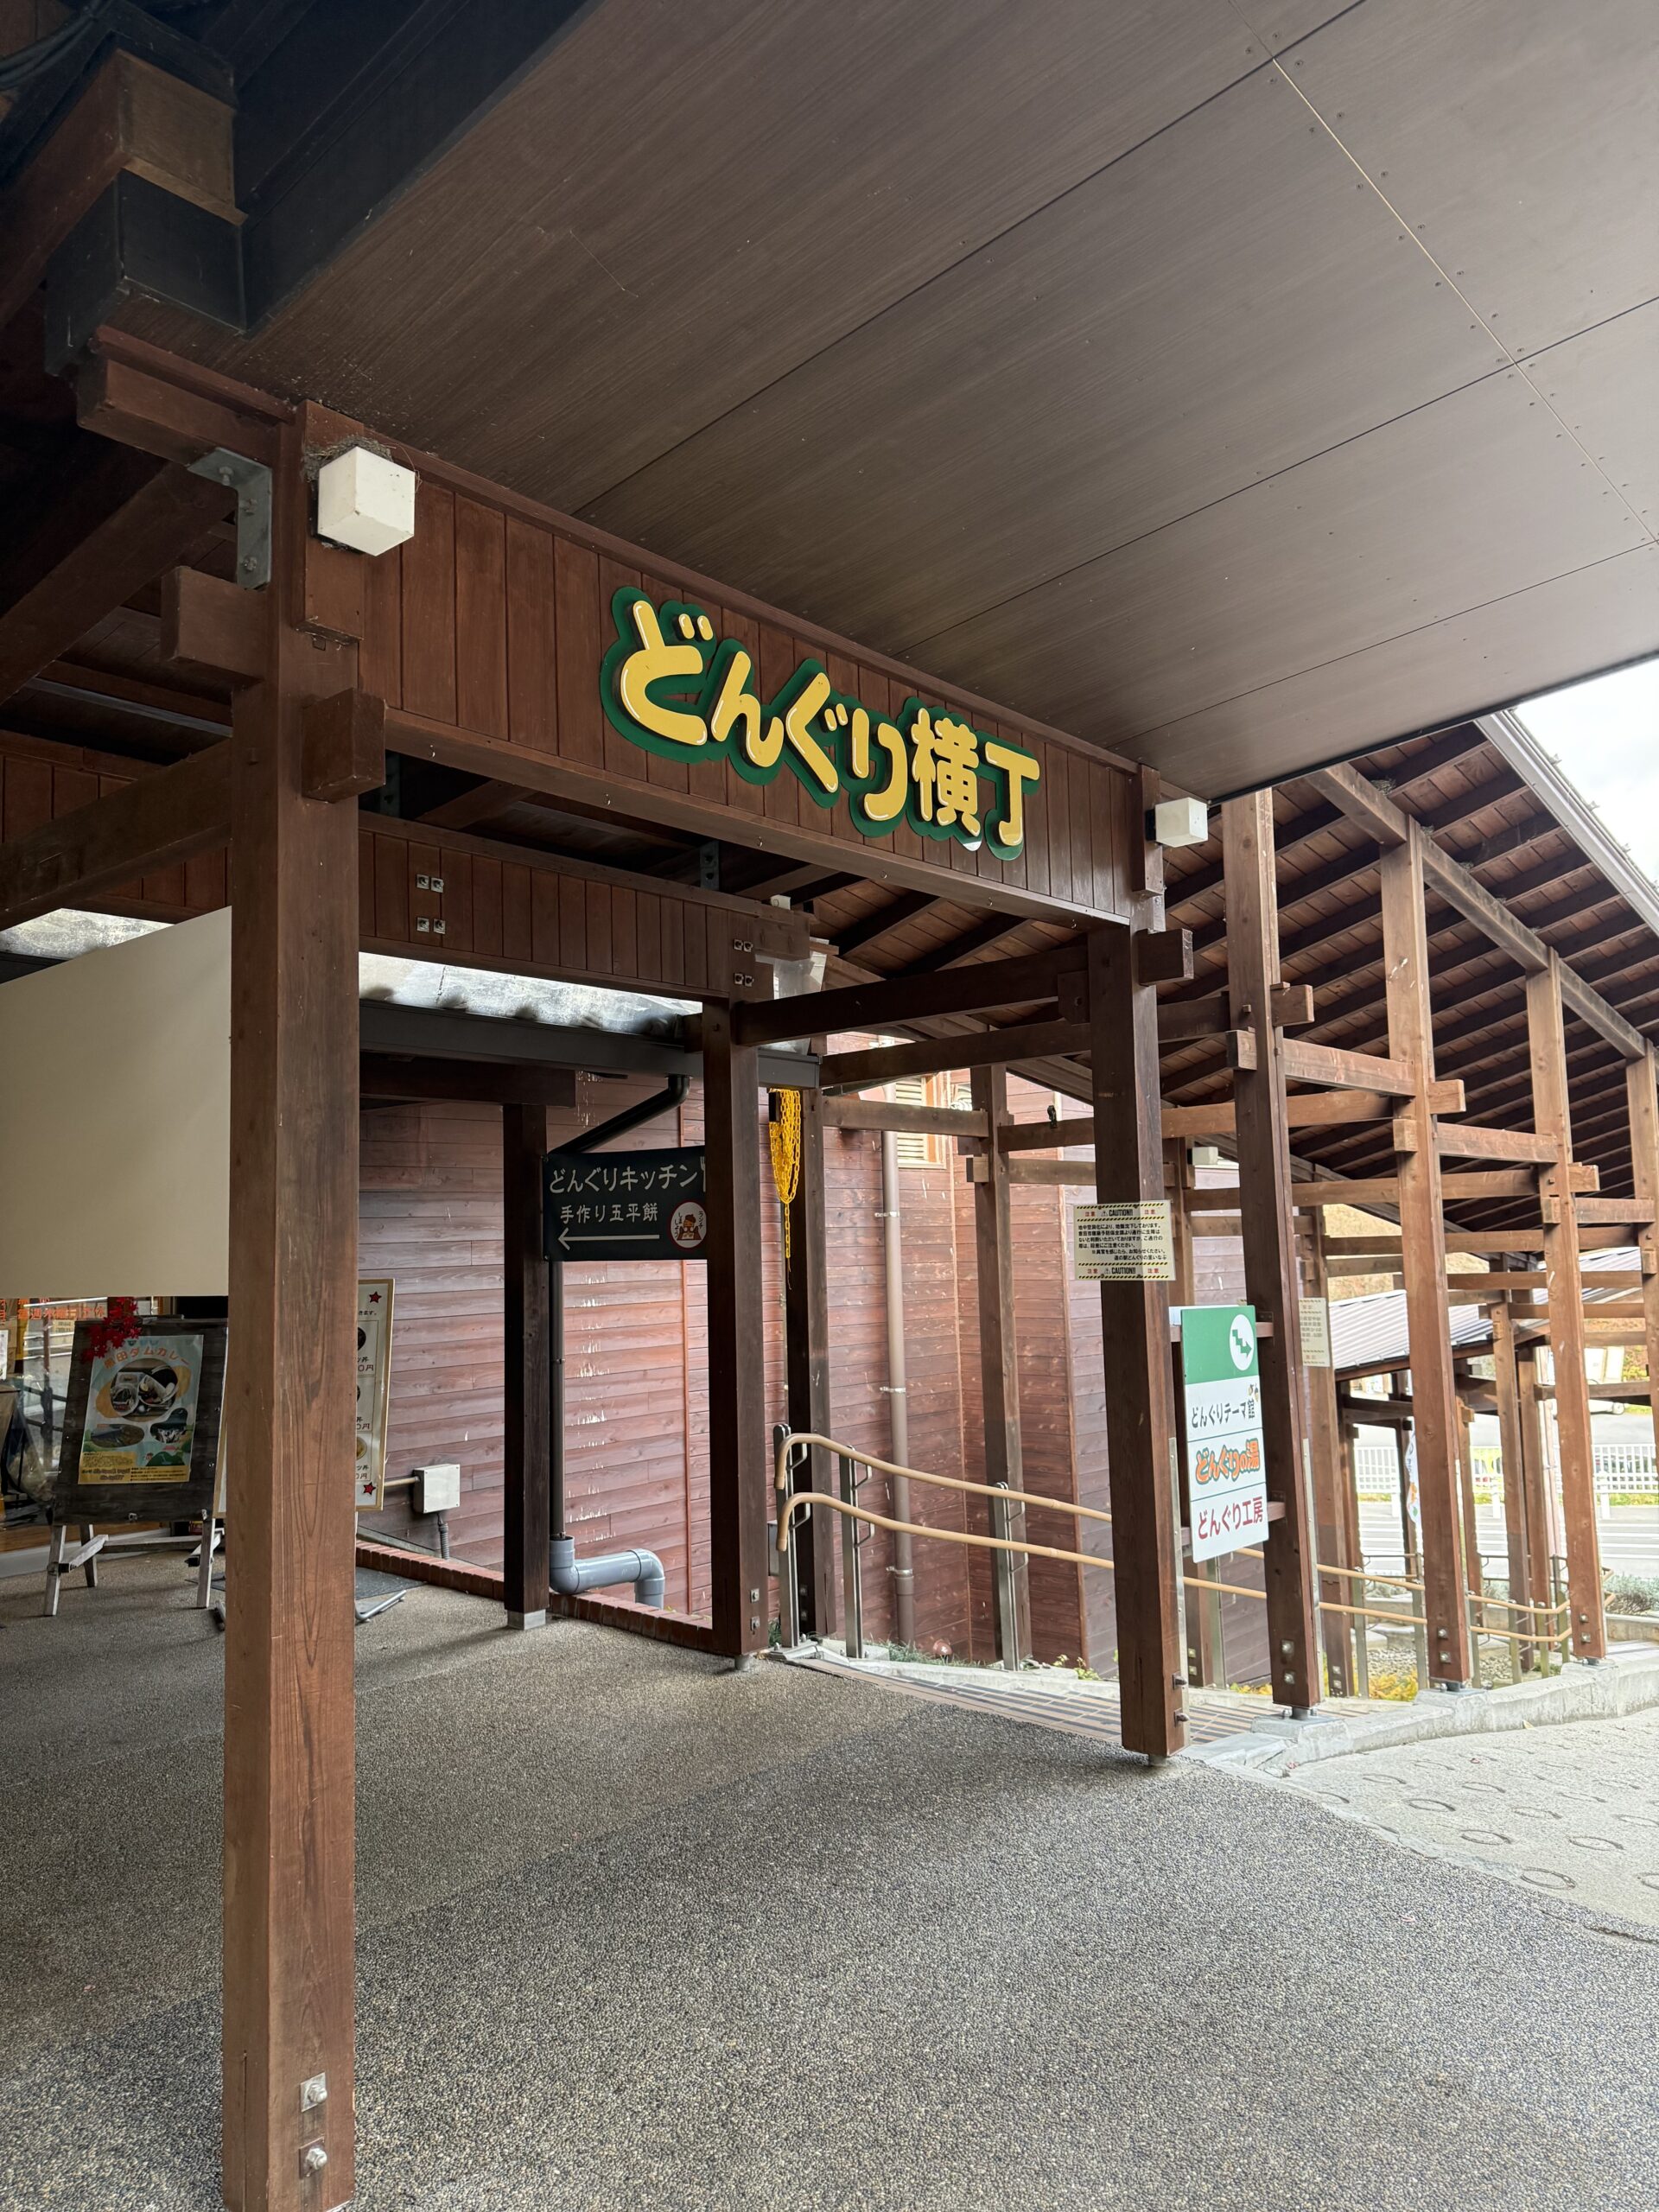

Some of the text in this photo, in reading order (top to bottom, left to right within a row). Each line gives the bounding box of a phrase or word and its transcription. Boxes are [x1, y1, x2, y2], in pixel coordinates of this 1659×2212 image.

[619, 600, 1040, 847] どんぐり横丁
[550, 1164, 698, 1194] どんぐりキッチン
[560, 1202, 658, 1224] 手作り五平餅
[1196, 1437, 1260, 1485] どんぐりの湯
[1198, 1496, 1264, 1540] どんぐり工房
